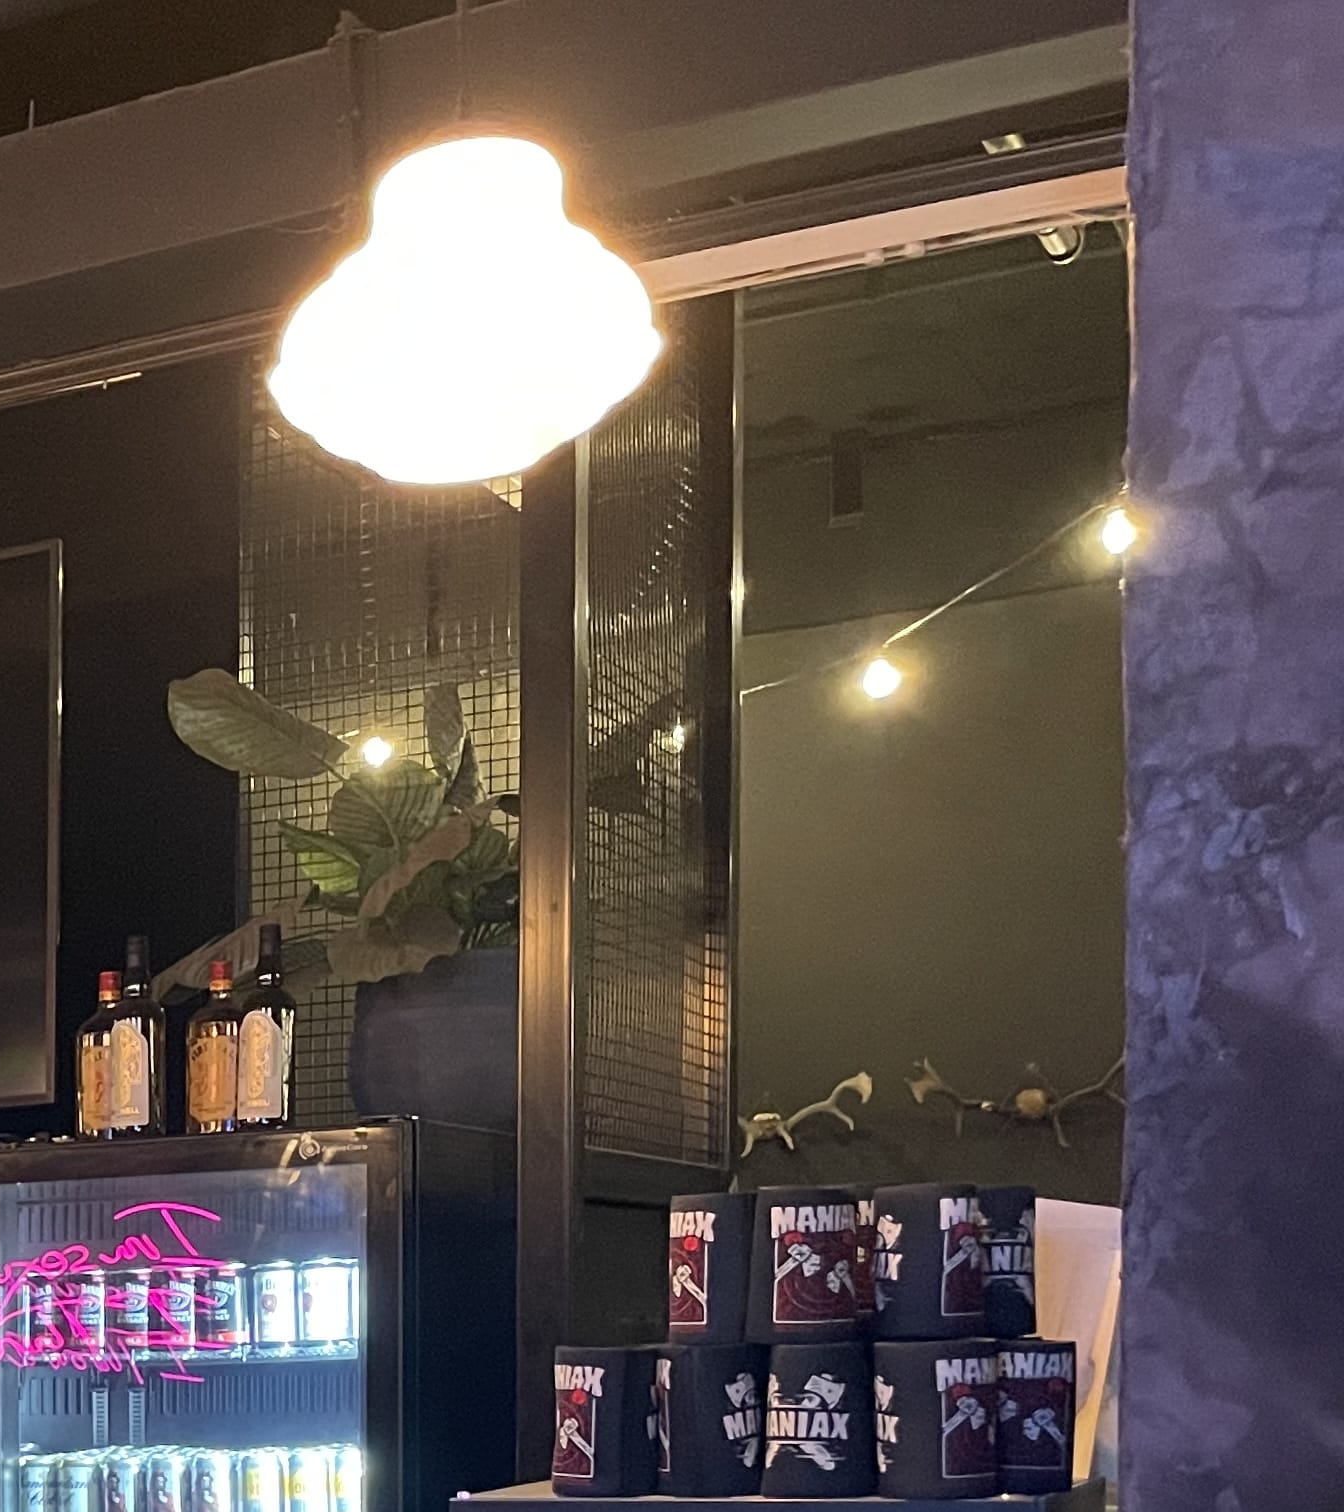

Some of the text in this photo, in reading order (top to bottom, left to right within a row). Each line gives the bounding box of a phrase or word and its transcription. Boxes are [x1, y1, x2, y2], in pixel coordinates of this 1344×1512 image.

[771, 1204, 857, 1238] MANIA
[998, 1352, 1073, 1384] ANIAX
[767, 1410, 851, 1440] ANIAX
